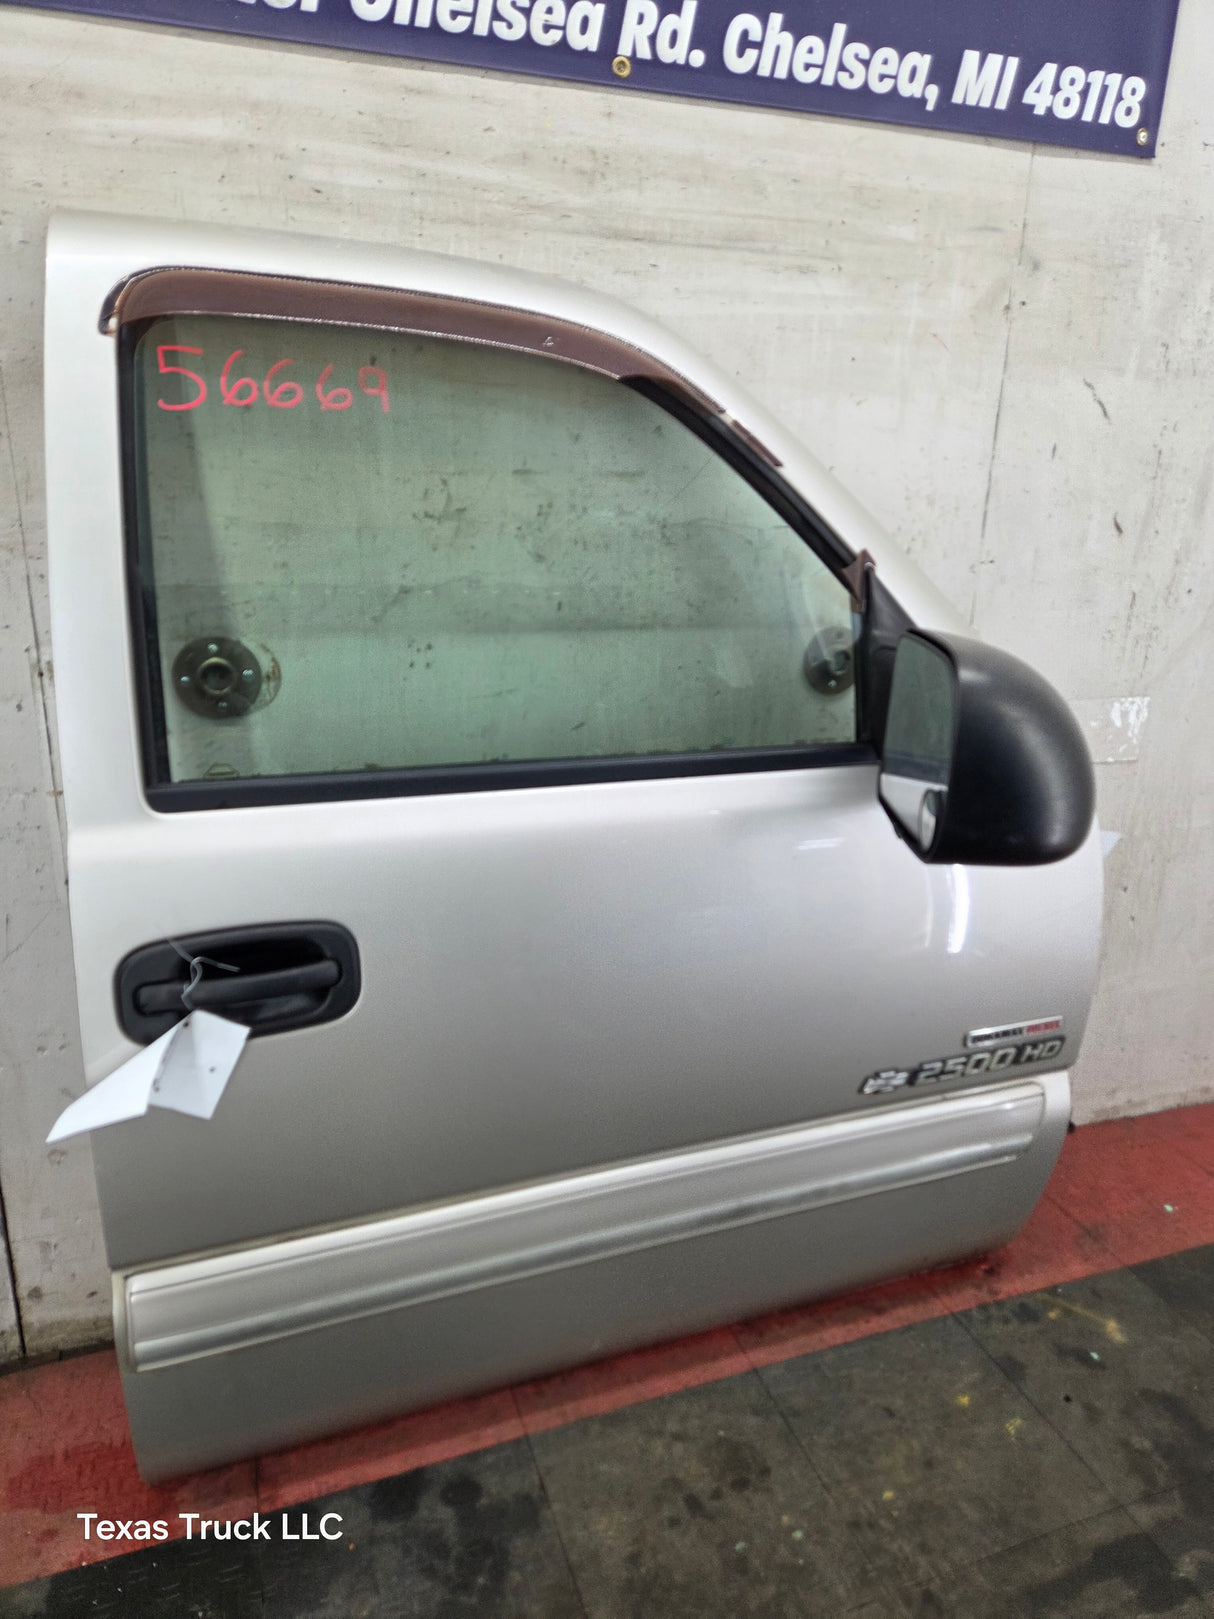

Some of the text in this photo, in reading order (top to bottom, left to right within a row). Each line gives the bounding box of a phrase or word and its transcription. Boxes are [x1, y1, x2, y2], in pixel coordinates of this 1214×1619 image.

[617, 0, 705, 68] Rd.
[722, 12, 940, 111] Chelsea,
[951, 49, 1019, 110] MI
[1021, 62, 1147, 128] 48118
[157, 344, 389, 412] 56669
[914, 1039, 1063, 1084] 2500 HD
